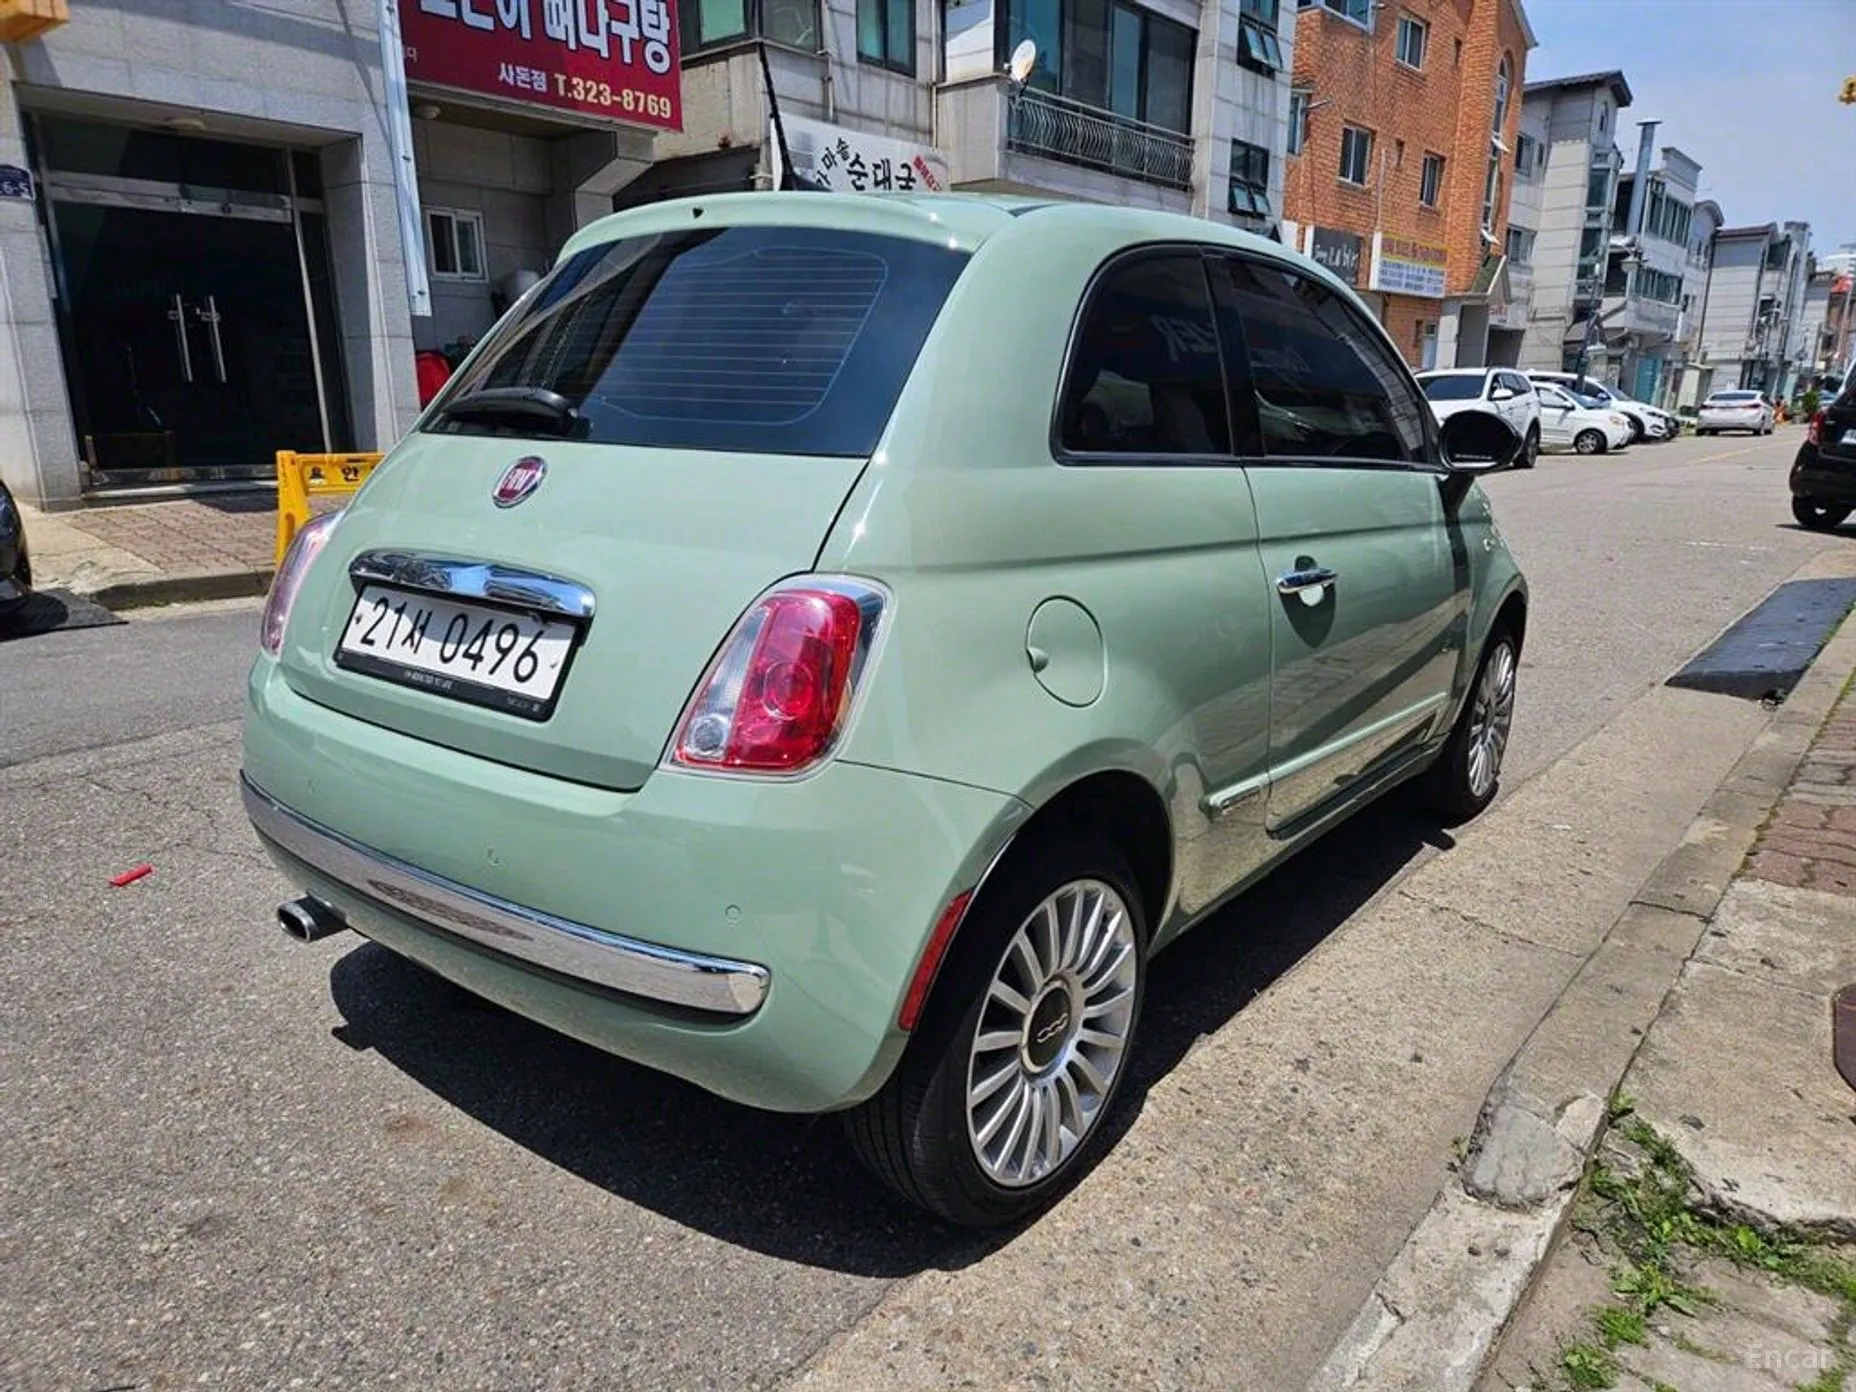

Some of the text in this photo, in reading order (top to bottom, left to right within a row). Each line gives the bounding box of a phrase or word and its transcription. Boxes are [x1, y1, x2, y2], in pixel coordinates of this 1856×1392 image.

[555, 73, 671, 119] T.323-8769
[846, 153, 916, 191] 순대국
[360, 596, 544, 684] 21서 0496
